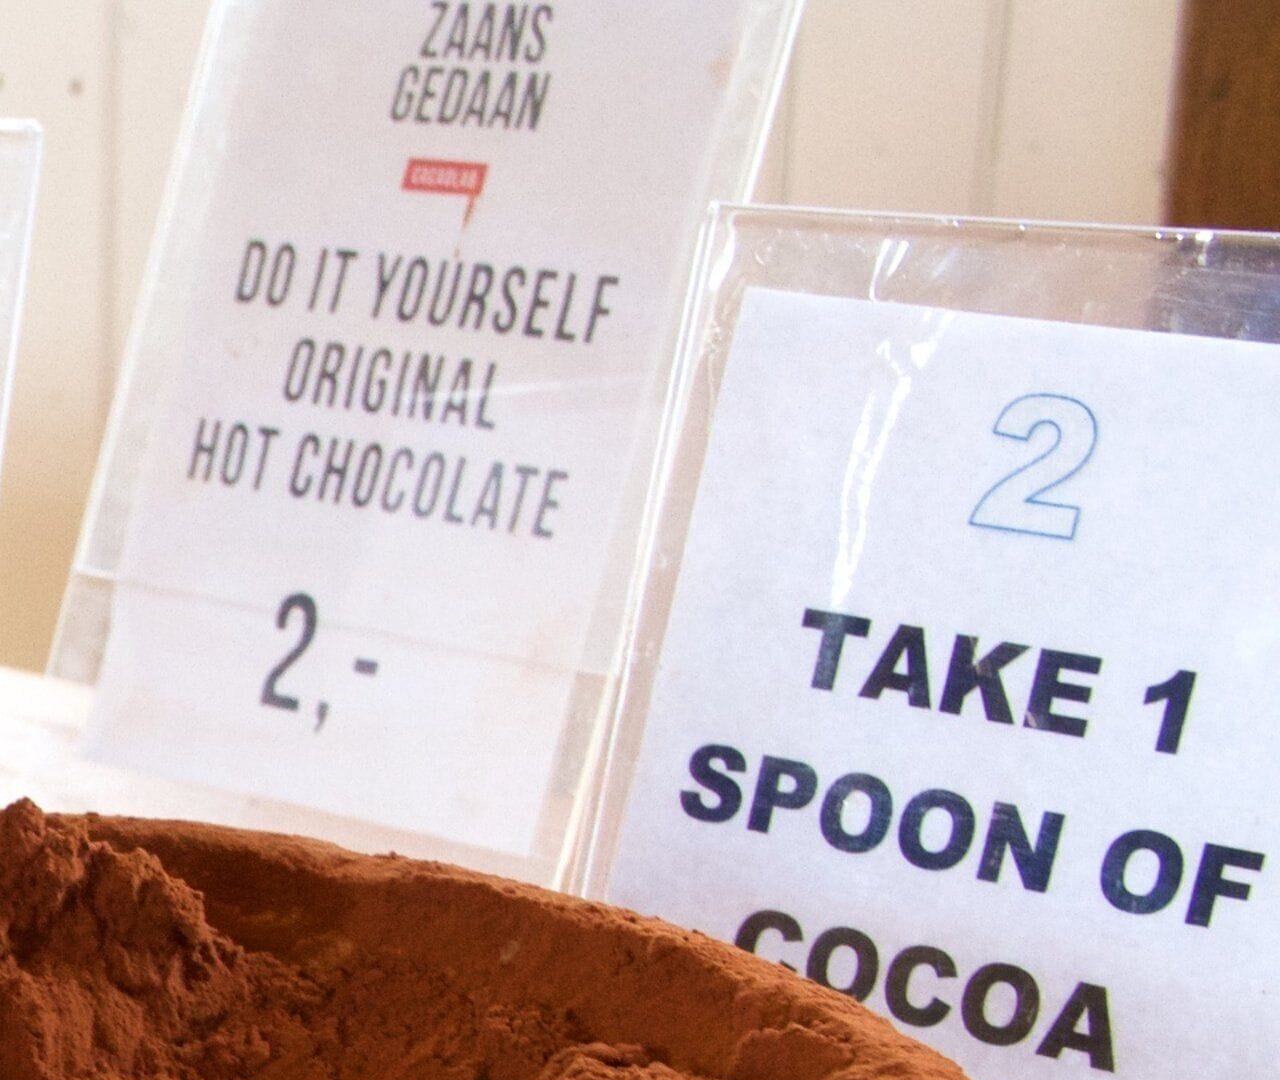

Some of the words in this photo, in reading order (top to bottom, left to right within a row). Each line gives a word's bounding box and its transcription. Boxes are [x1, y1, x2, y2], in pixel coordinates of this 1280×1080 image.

[420, 0, 554, 64] ZAANS
[391, 64, 552, 131] GEDAAN
[236, 240, 297, 306] DO
[308, 247, 358, 314] IT
[371, 253, 620, 344] YOURSELF
[283, 338, 497, 430] ORIGINAL
[186, 417, 280, 491] HOT
[289, 432, 569, 539] CHOCOLATE
[968, 392, 1098, 540] 2
[801, 607, 1103, 739] TAKE
[1142, 668, 1198, 755] 1
[679, 743, 1066, 894] SPOON
[1099, 829, 1266, 928] OF
[735, 909, 1116, 1074] COCOA
